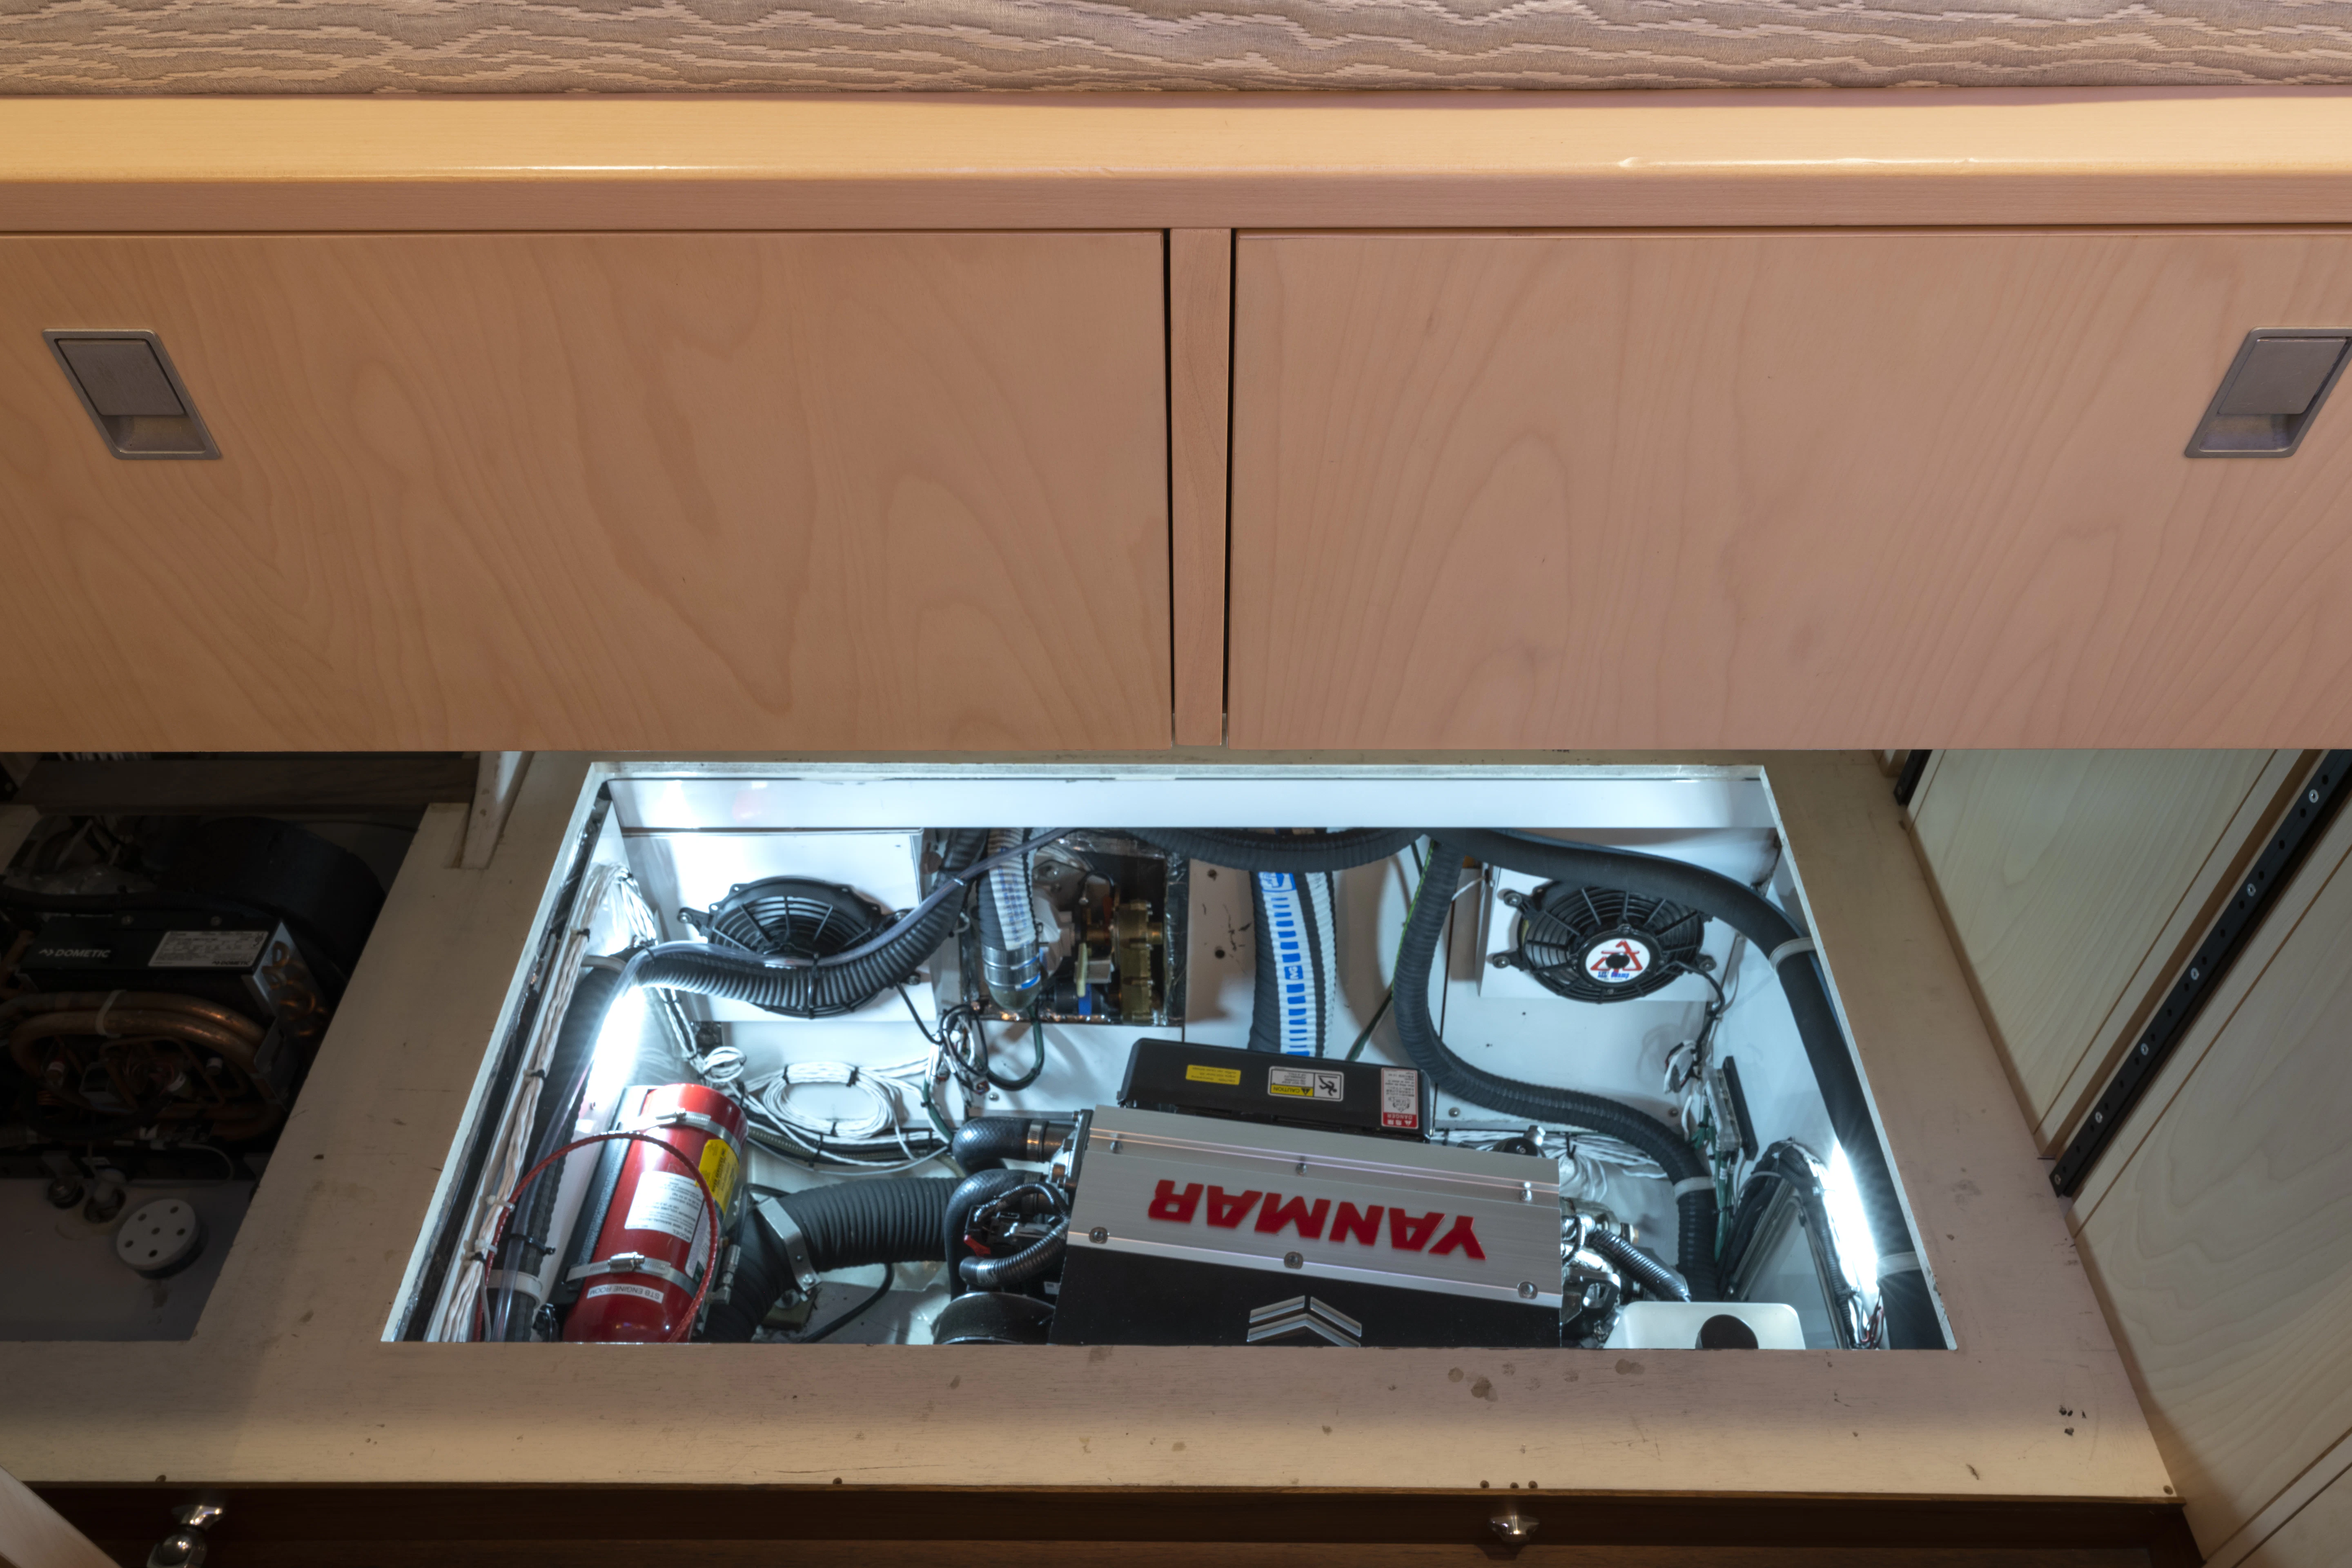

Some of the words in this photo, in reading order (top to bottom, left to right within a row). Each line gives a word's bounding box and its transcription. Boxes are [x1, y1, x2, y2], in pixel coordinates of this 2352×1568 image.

[54, 949, 111, 959] DOMETIC
[1148, 1179, 1486, 1261] YANMAR
[673, 1229, 690, 1241] MODEL
[590, 1286, 612, 1296] ROOM
[613, 1285, 643, 1294] ENGINE
[645, 1290, 660, 1300] STB
